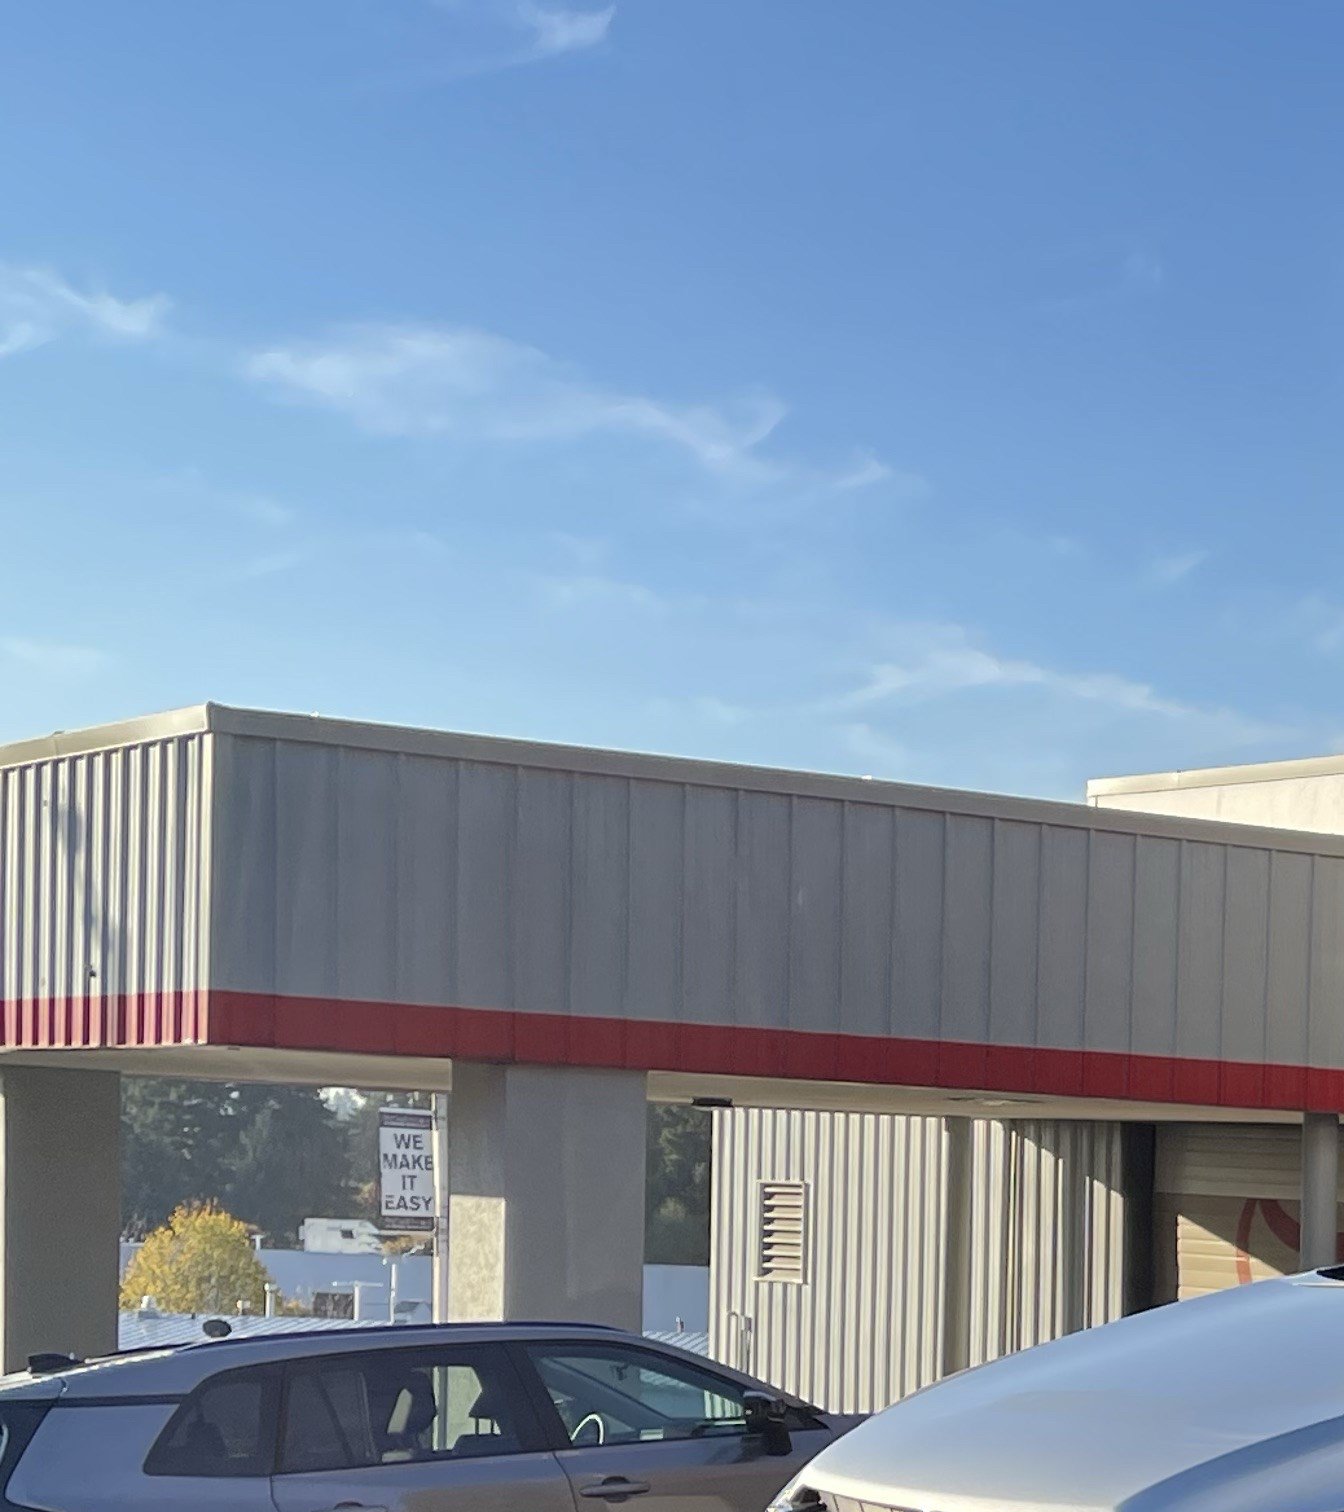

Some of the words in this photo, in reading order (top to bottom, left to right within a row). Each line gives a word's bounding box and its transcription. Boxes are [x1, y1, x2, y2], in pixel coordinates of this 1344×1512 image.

[393, 1133, 424, 1150] WE
[382, 1153, 433, 1171] MAKE
[401, 1174, 417, 1191] IT
[385, 1194, 432, 1211] EASY
